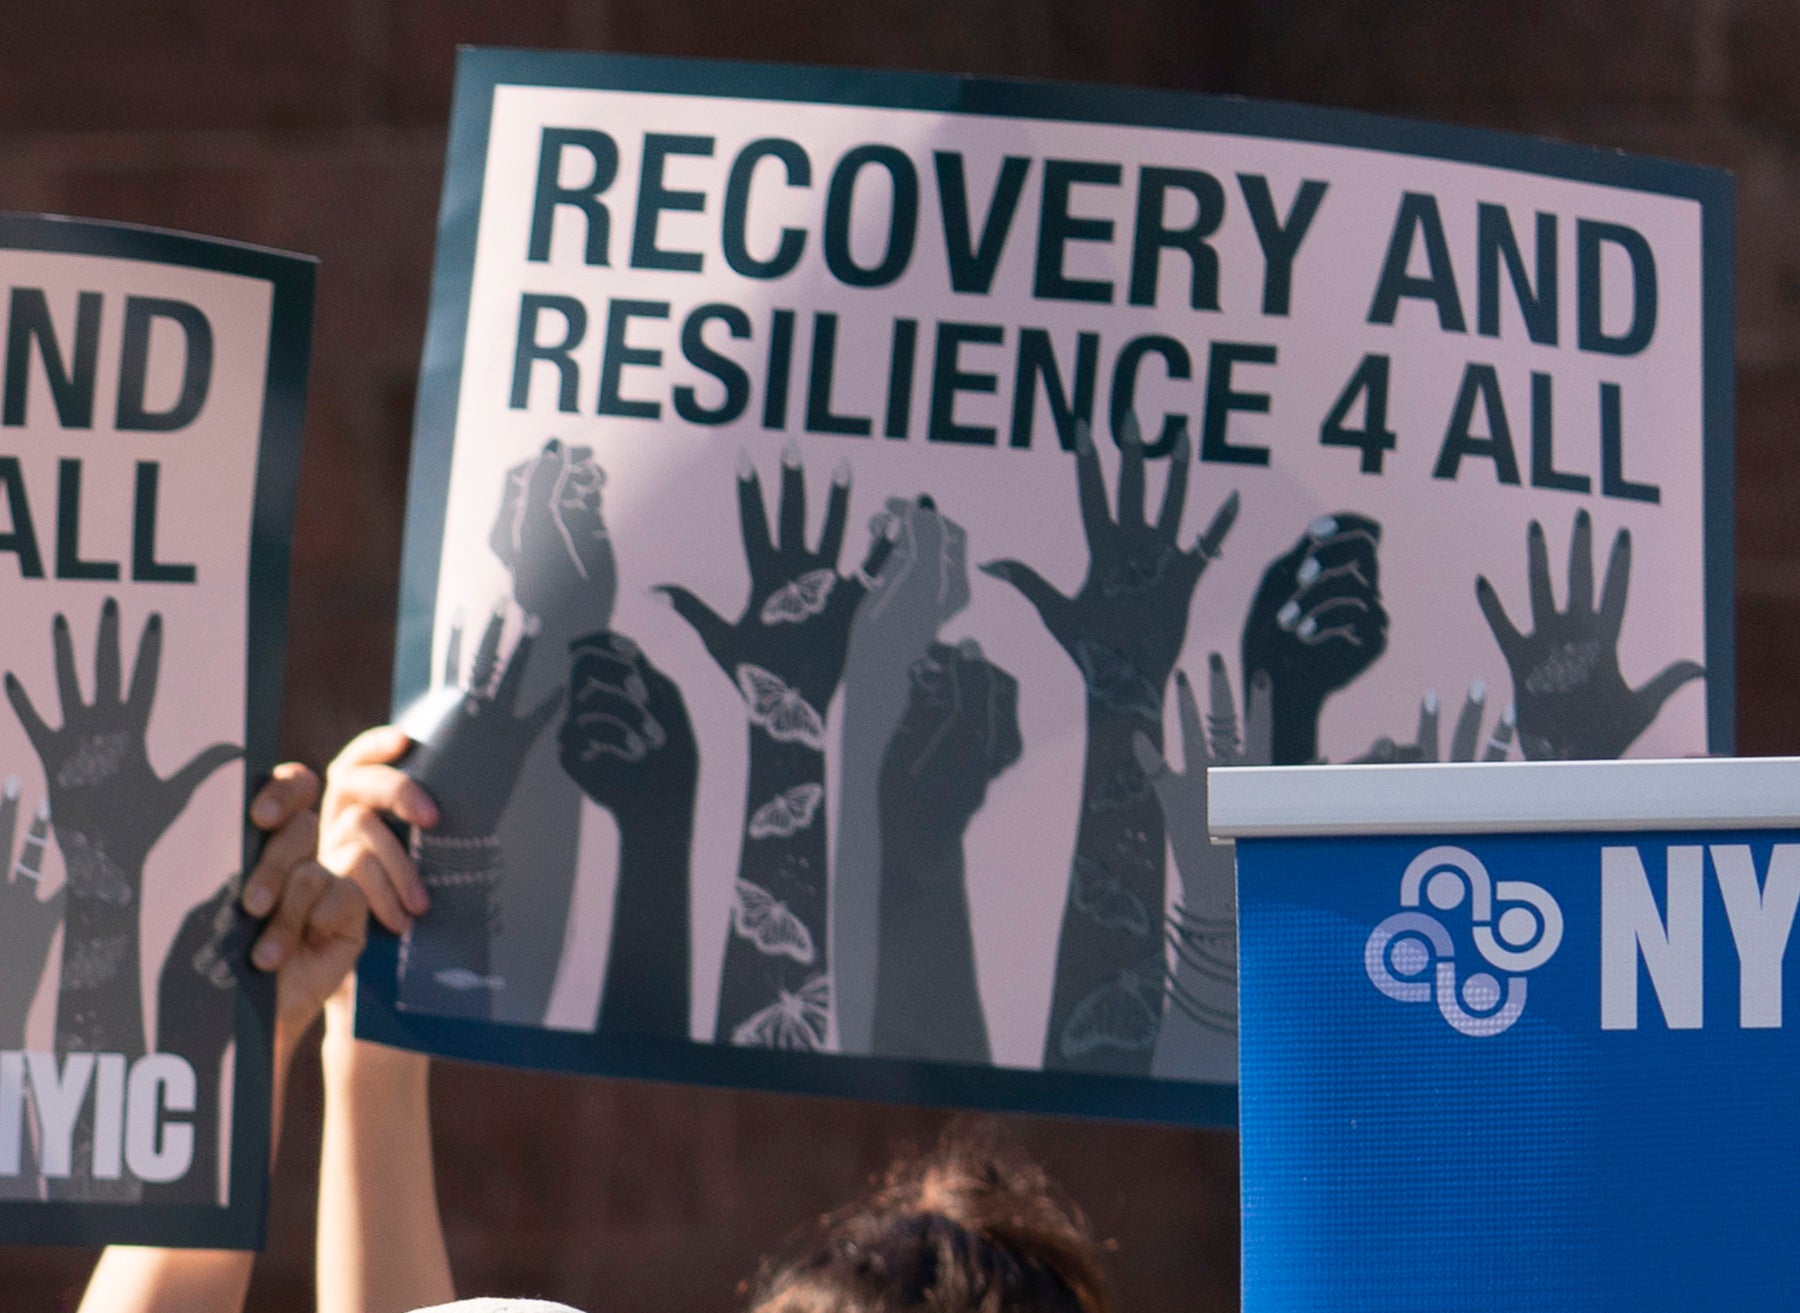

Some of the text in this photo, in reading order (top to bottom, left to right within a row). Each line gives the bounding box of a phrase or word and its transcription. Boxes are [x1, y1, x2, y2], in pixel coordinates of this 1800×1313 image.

[526, 126, 1659, 357] RECOVERY AND
[507, 291, 1662, 505] RESILIENCE 4 ALL
